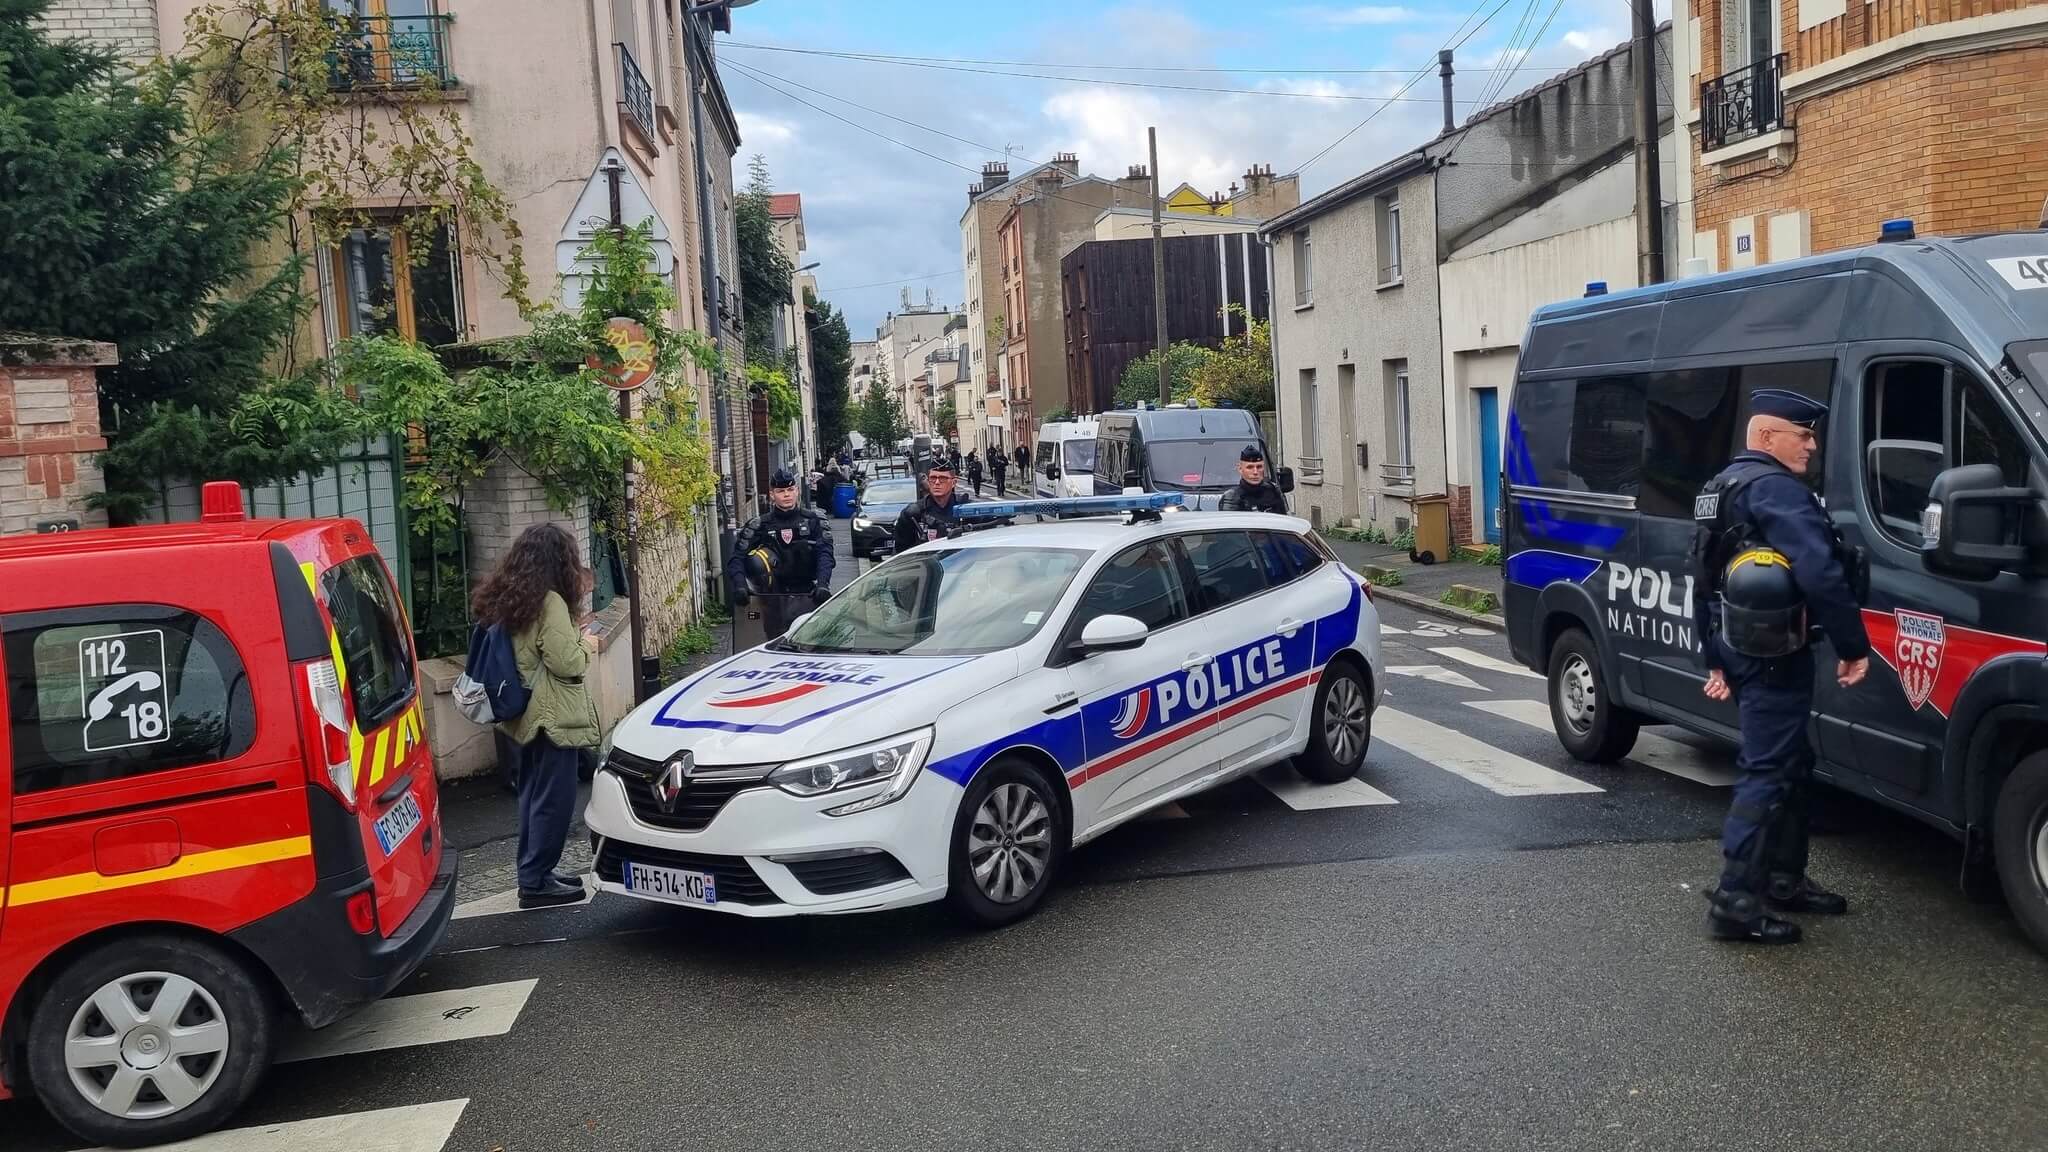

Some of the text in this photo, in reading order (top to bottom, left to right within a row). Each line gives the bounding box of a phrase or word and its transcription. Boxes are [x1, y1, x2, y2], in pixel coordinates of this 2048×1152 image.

[1739, 237, 1749, 251] 18
[1697, 498, 1716, 516] CRS
[1608, 561, 1695, 619] POLI
[1608, 607, 1703, 653] NATION
[1901, 625, 1941, 642] NATIONALE
[1902, 616, 1937, 631] POLICE
[85, 640, 127, 677] 112
[770, 661, 874, 672] POLICE
[1898, 639, 1938, 669] CRS
[716, 669, 886, 686] NATIONALE
[1156, 639, 1286, 724] POLICE
[121, 702, 163, 739] 18
[632, 867, 704, 899] FH-514-KD
